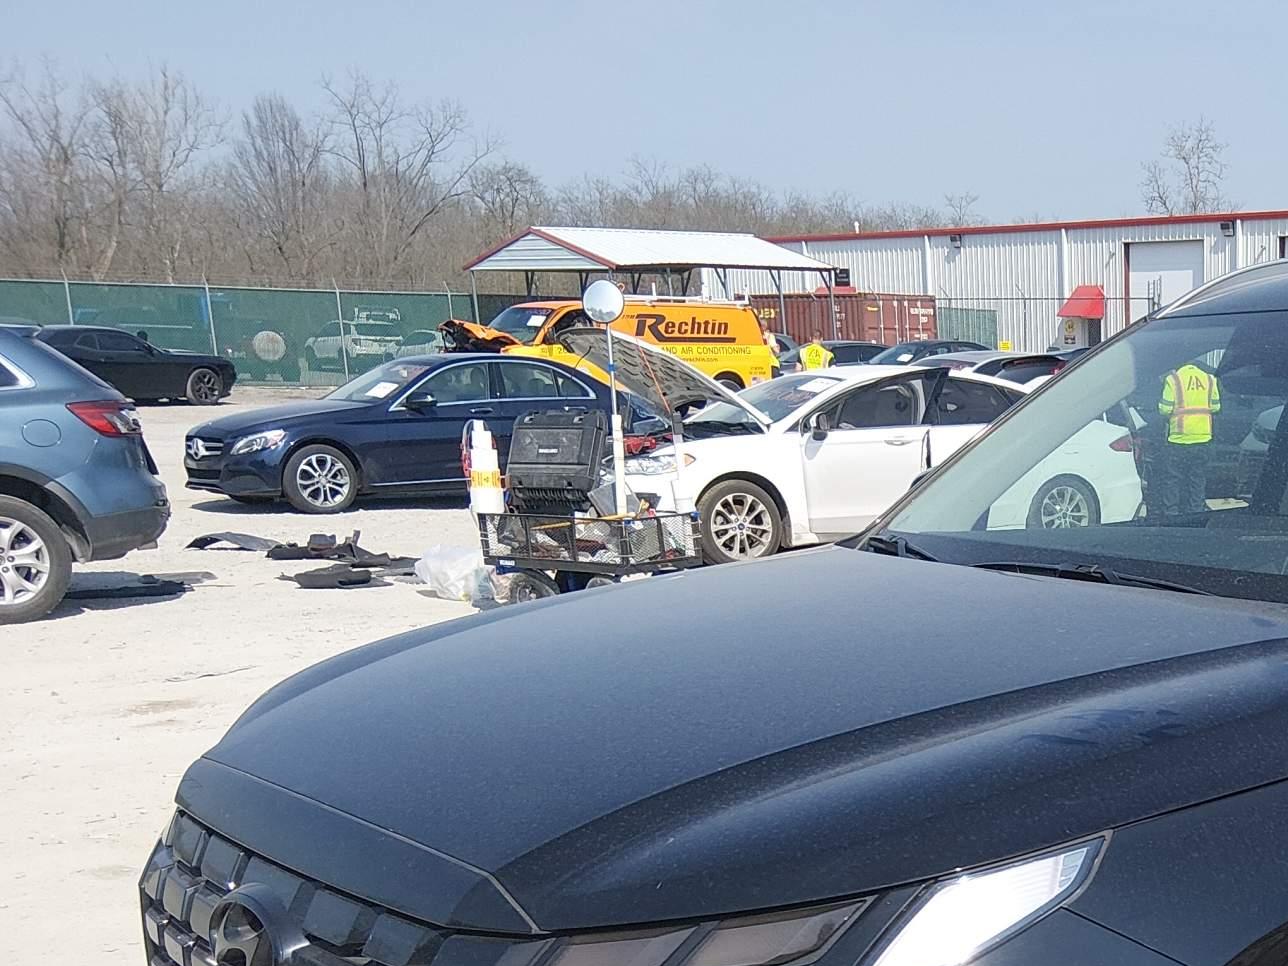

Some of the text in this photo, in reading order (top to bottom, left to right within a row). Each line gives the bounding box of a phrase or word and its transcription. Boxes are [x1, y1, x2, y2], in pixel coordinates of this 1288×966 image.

[635, 313, 730, 341] Rechtin
[681, 346, 694, 356] AIR
[696, 346, 752, 356] CONDITIONING
